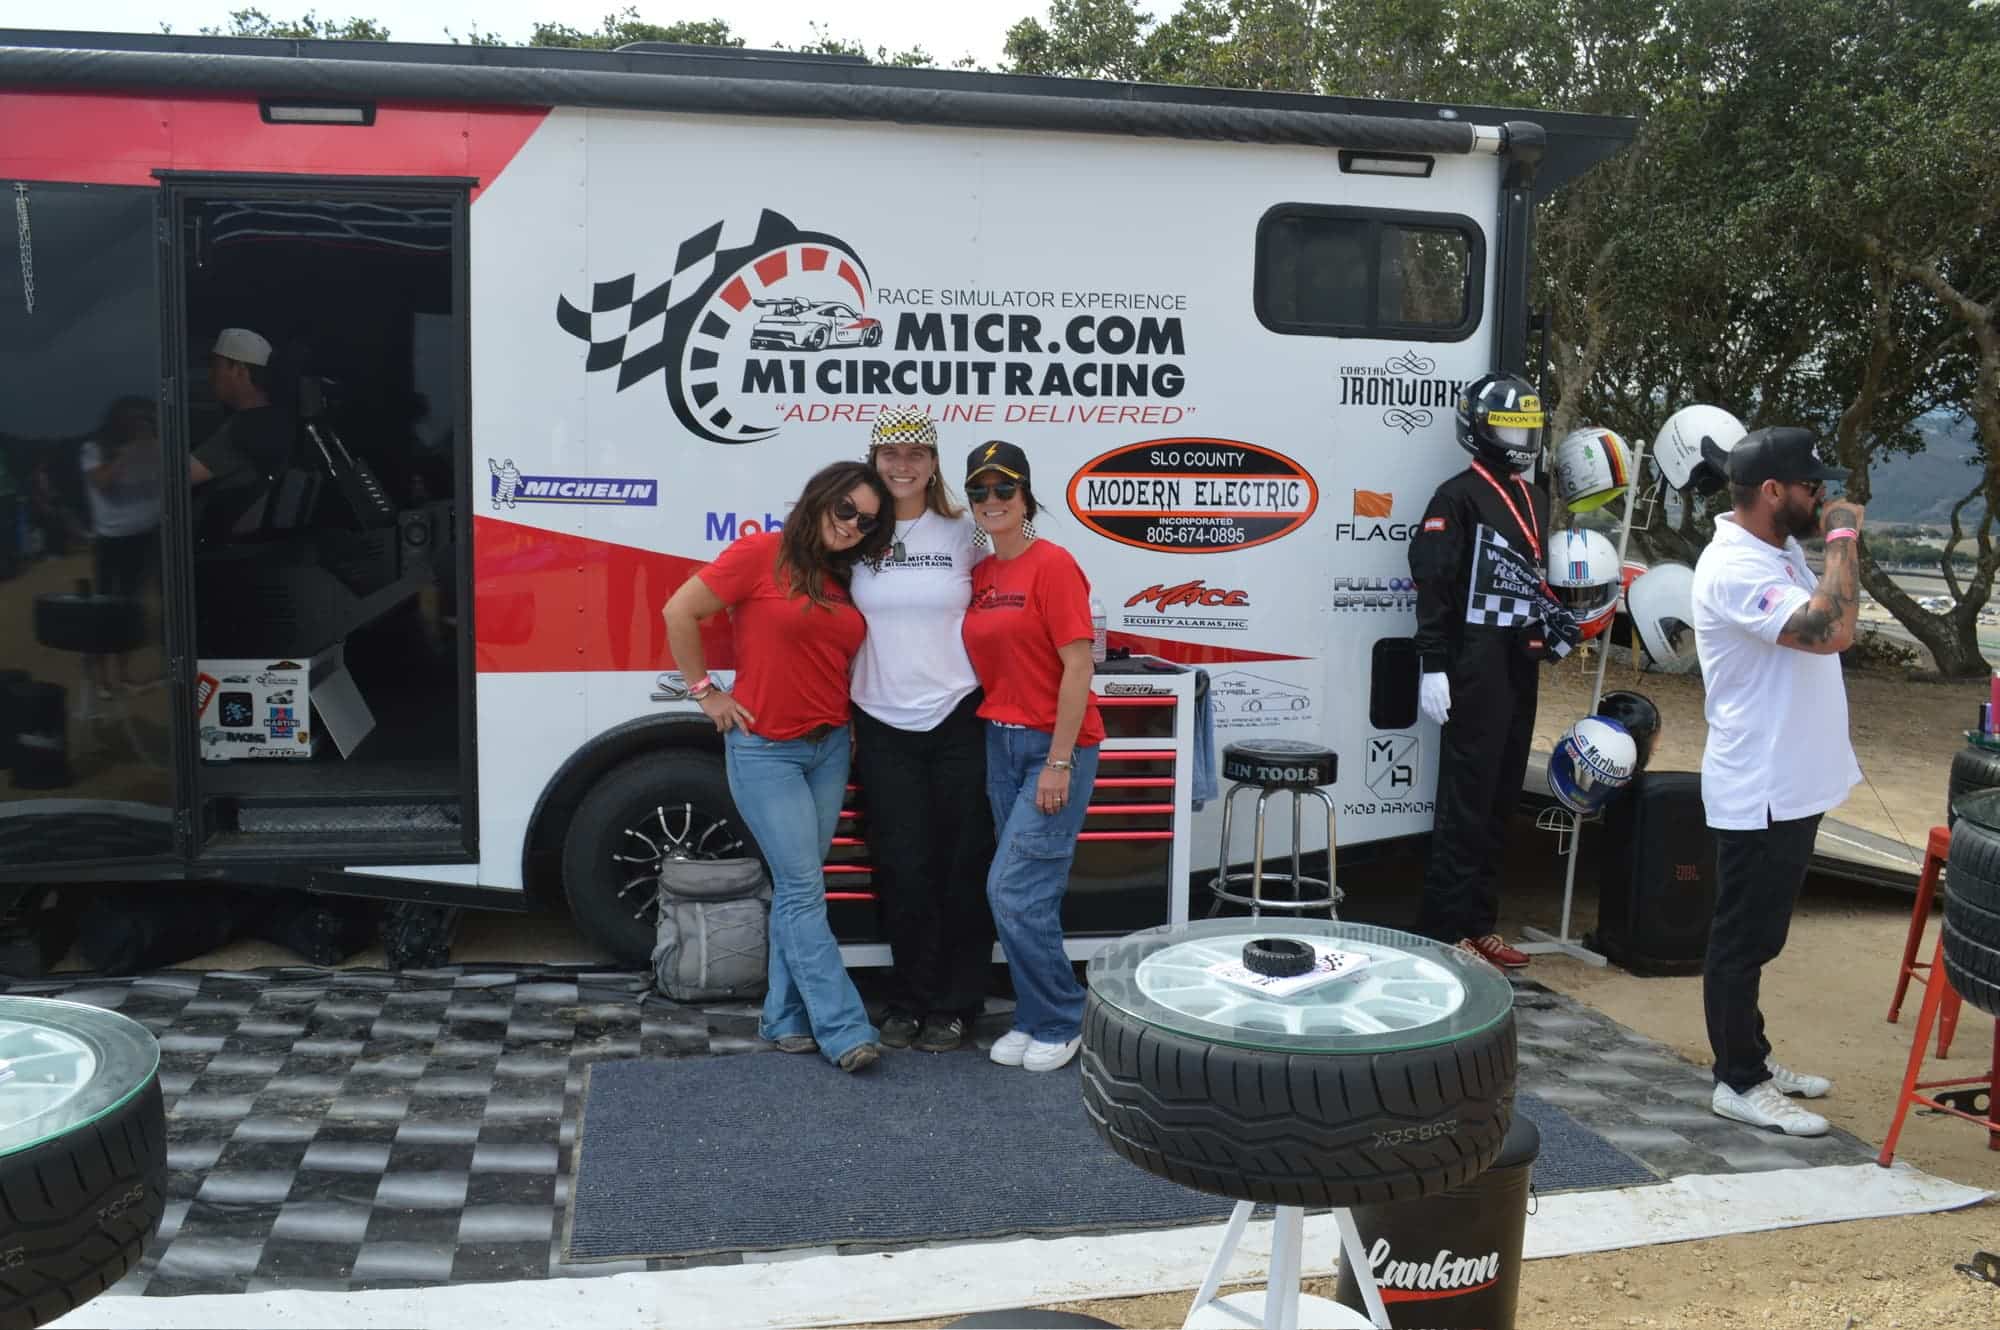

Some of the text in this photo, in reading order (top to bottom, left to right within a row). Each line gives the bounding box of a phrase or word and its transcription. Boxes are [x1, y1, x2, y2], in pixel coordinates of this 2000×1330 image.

[878, 289, 1187, 310] RACE SIMULATOR EXPERIENCE
[894, 312, 1186, 355] M1CR.COM
[741, 358, 1185, 399] M1 CIRCUIT RACING
[1340, 366, 1386, 376] COASTAL
[1339, 376, 1470, 408] IRONWORK
[1150, 451, 1245, 467] SLO COUNTY
[524, 480, 652, 500] MICHELIN
[1087, 479, 1300, 512] MODERN ELECTRIC
[706, 511, 784, 542] Mob
[1159, 517, 1233, 526] INCORPORATED
[1146, 527, 1245, 544] 805-674-0895
[1334, 577, 1388, 591] FULL
[1123, 616, 1173, 626] SECURITY
[1256, 767, 1320, 782] TOOLS
[1344, 803, 1376, 816] MOB
